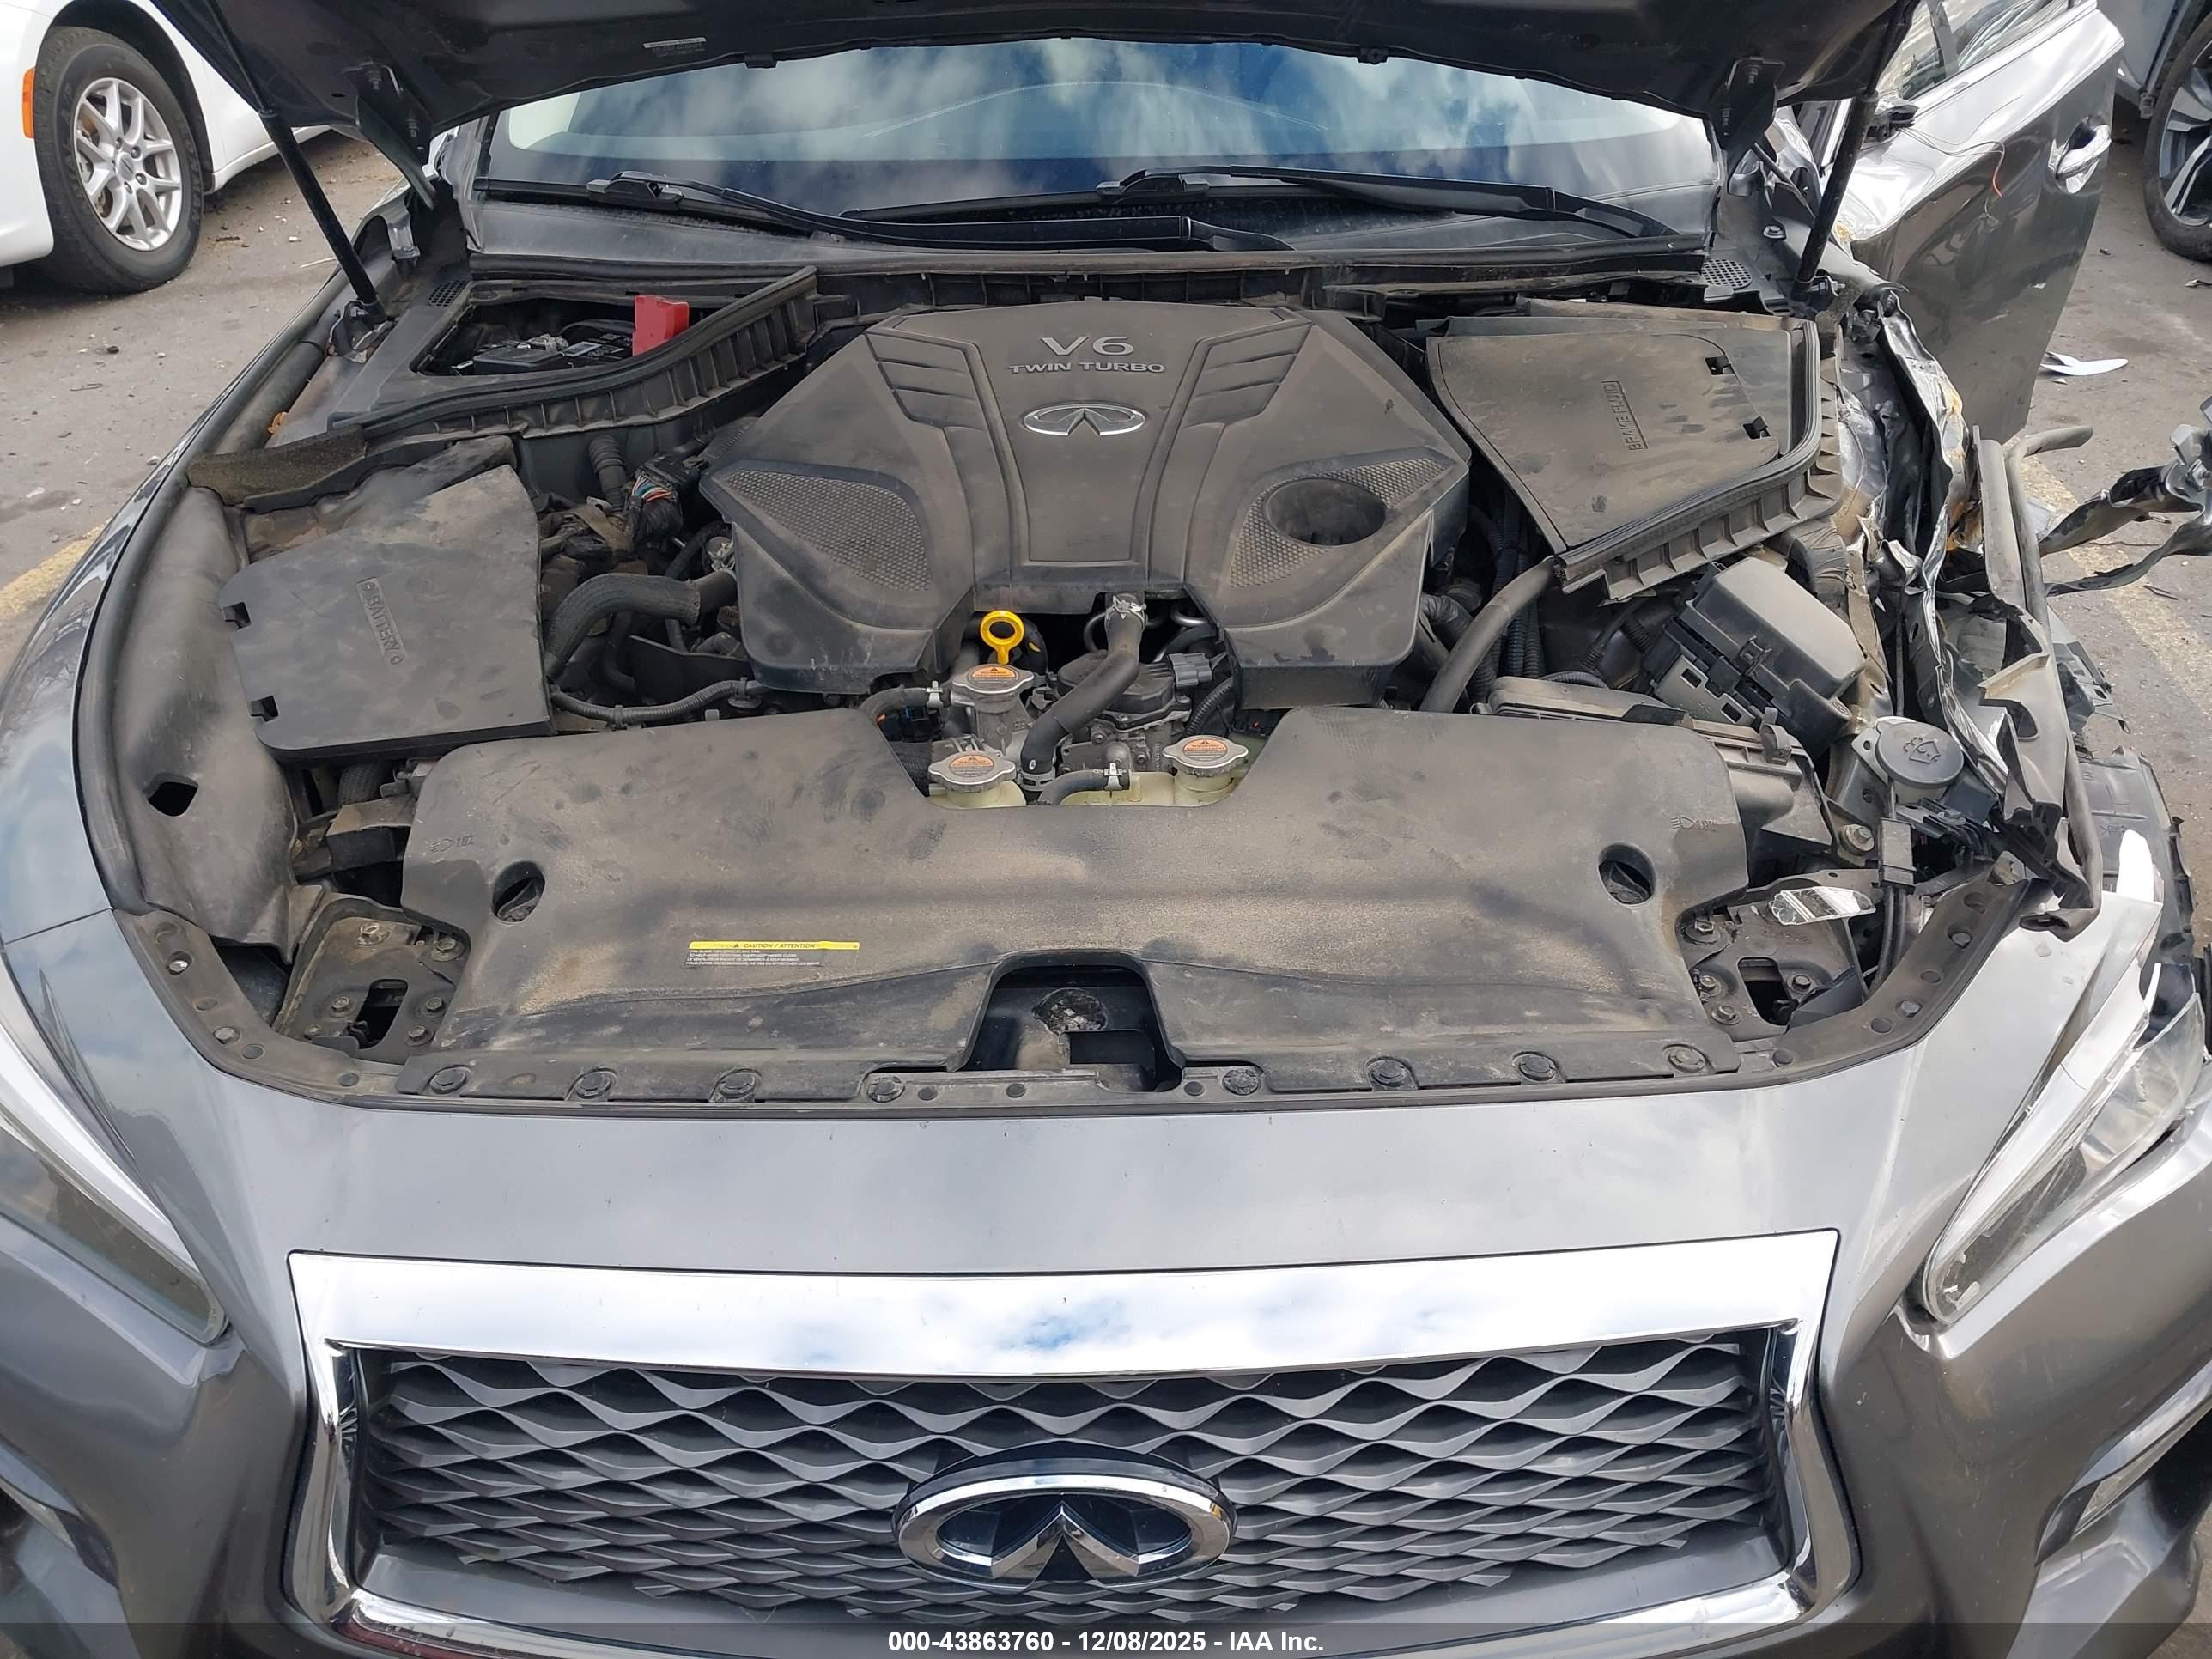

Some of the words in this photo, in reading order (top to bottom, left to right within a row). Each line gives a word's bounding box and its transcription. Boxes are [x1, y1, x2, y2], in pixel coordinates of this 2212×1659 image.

[1040, 336, 1134, 356] V6
[1009, 362, 1072, 373] TWIN
[1079, 362, 1166, 373] TURBO
[1603, 384, 1627, 414] FLUID
[1616, 416, 1644, 451] BRAKE
[366, 596, 401, 652] BATTERY
